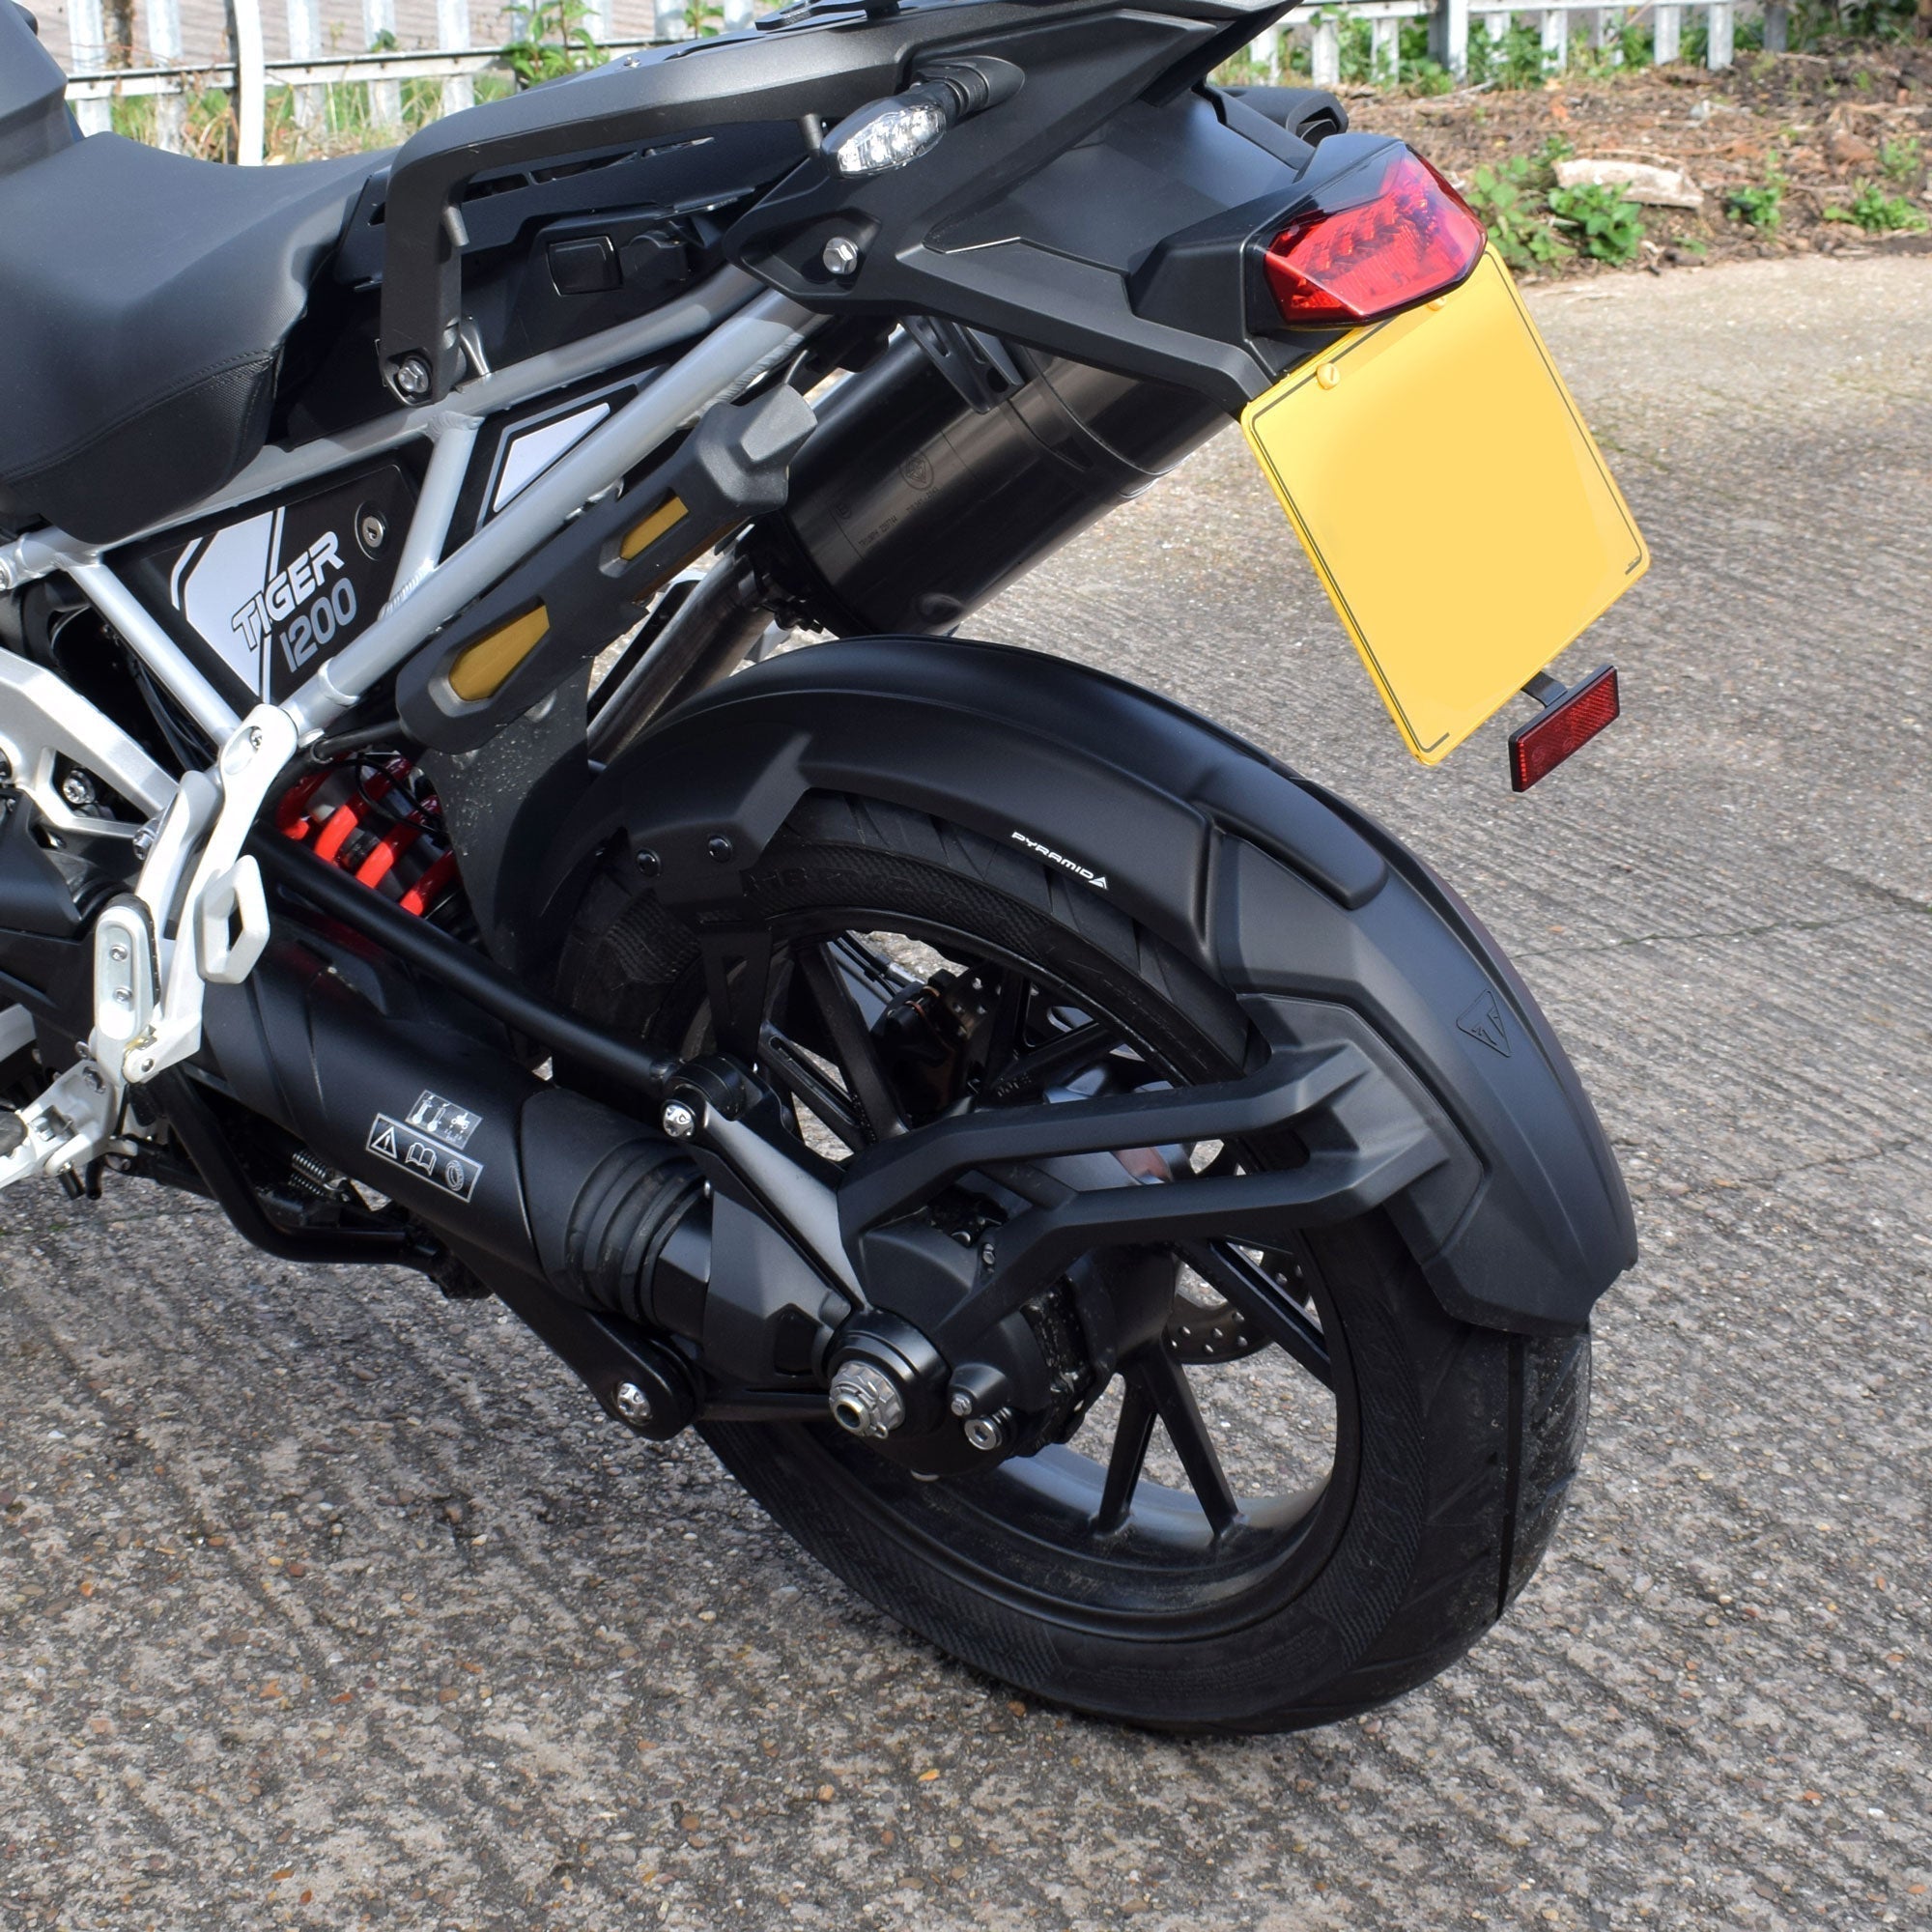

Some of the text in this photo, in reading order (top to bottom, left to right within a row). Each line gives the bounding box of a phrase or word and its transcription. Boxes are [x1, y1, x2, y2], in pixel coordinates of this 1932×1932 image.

[231, 530, 345, 651] TIGER
[279, 577, 357, 673] 1200
[1011, 831, 1094, 880] PYRAMID
